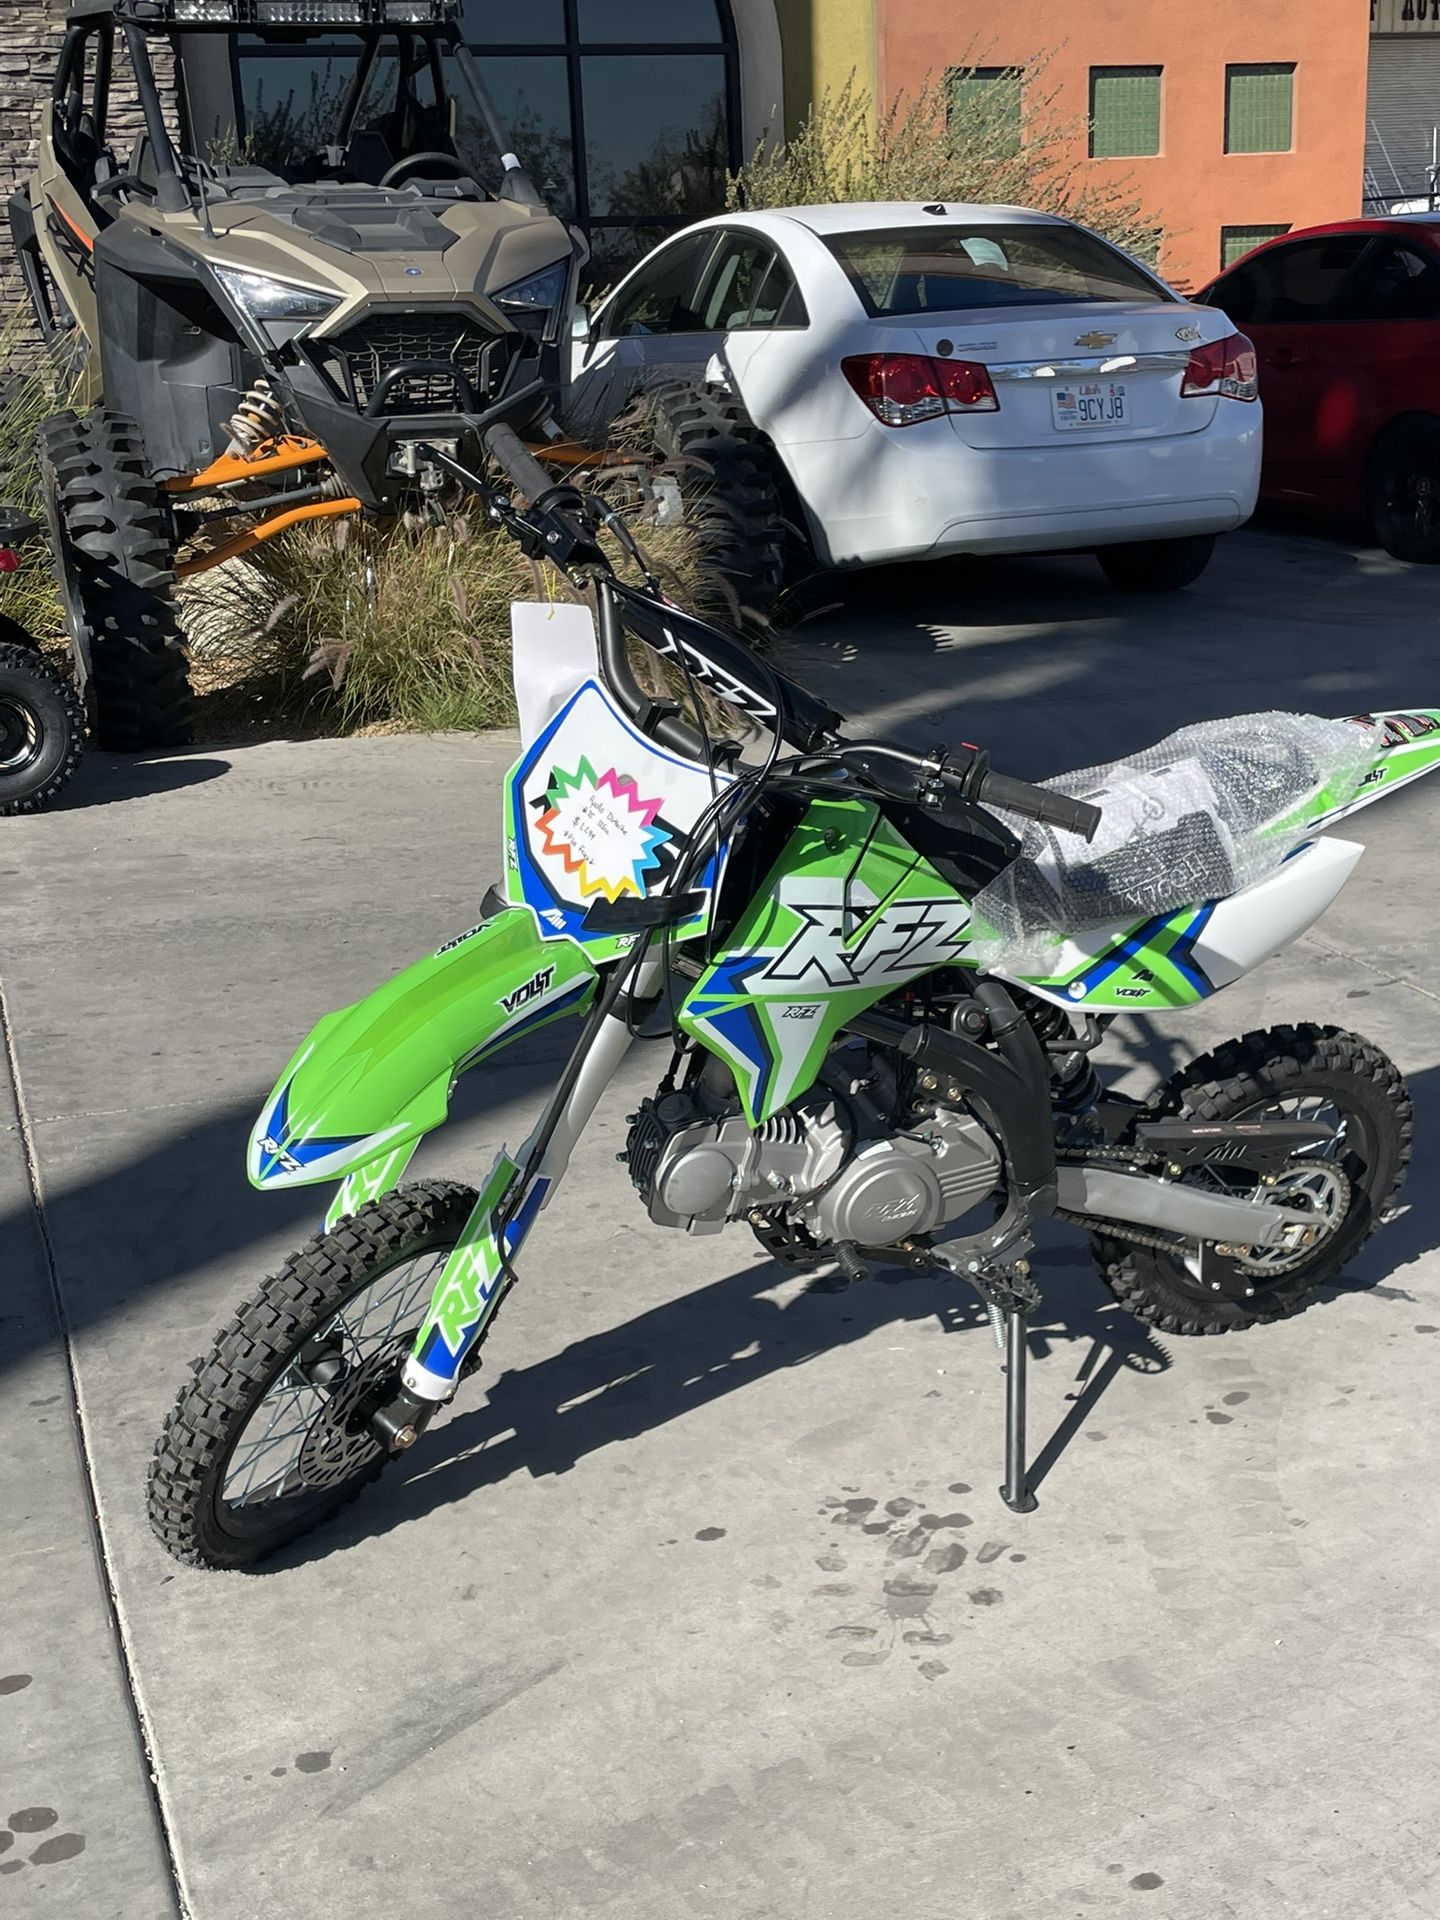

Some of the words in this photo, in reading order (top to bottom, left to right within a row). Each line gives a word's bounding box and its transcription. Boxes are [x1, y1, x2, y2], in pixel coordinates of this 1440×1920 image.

[1078, 397, 1124, 421] 9CYJ8
[615, 932, 641, 949] RF
[761, 899, 974, 988] RFZ
[498, 963, 556, 1014] VOLT
[782, 1004, 822, 1019] RFZ
[257, 1133, 306, 1172] RFZ
